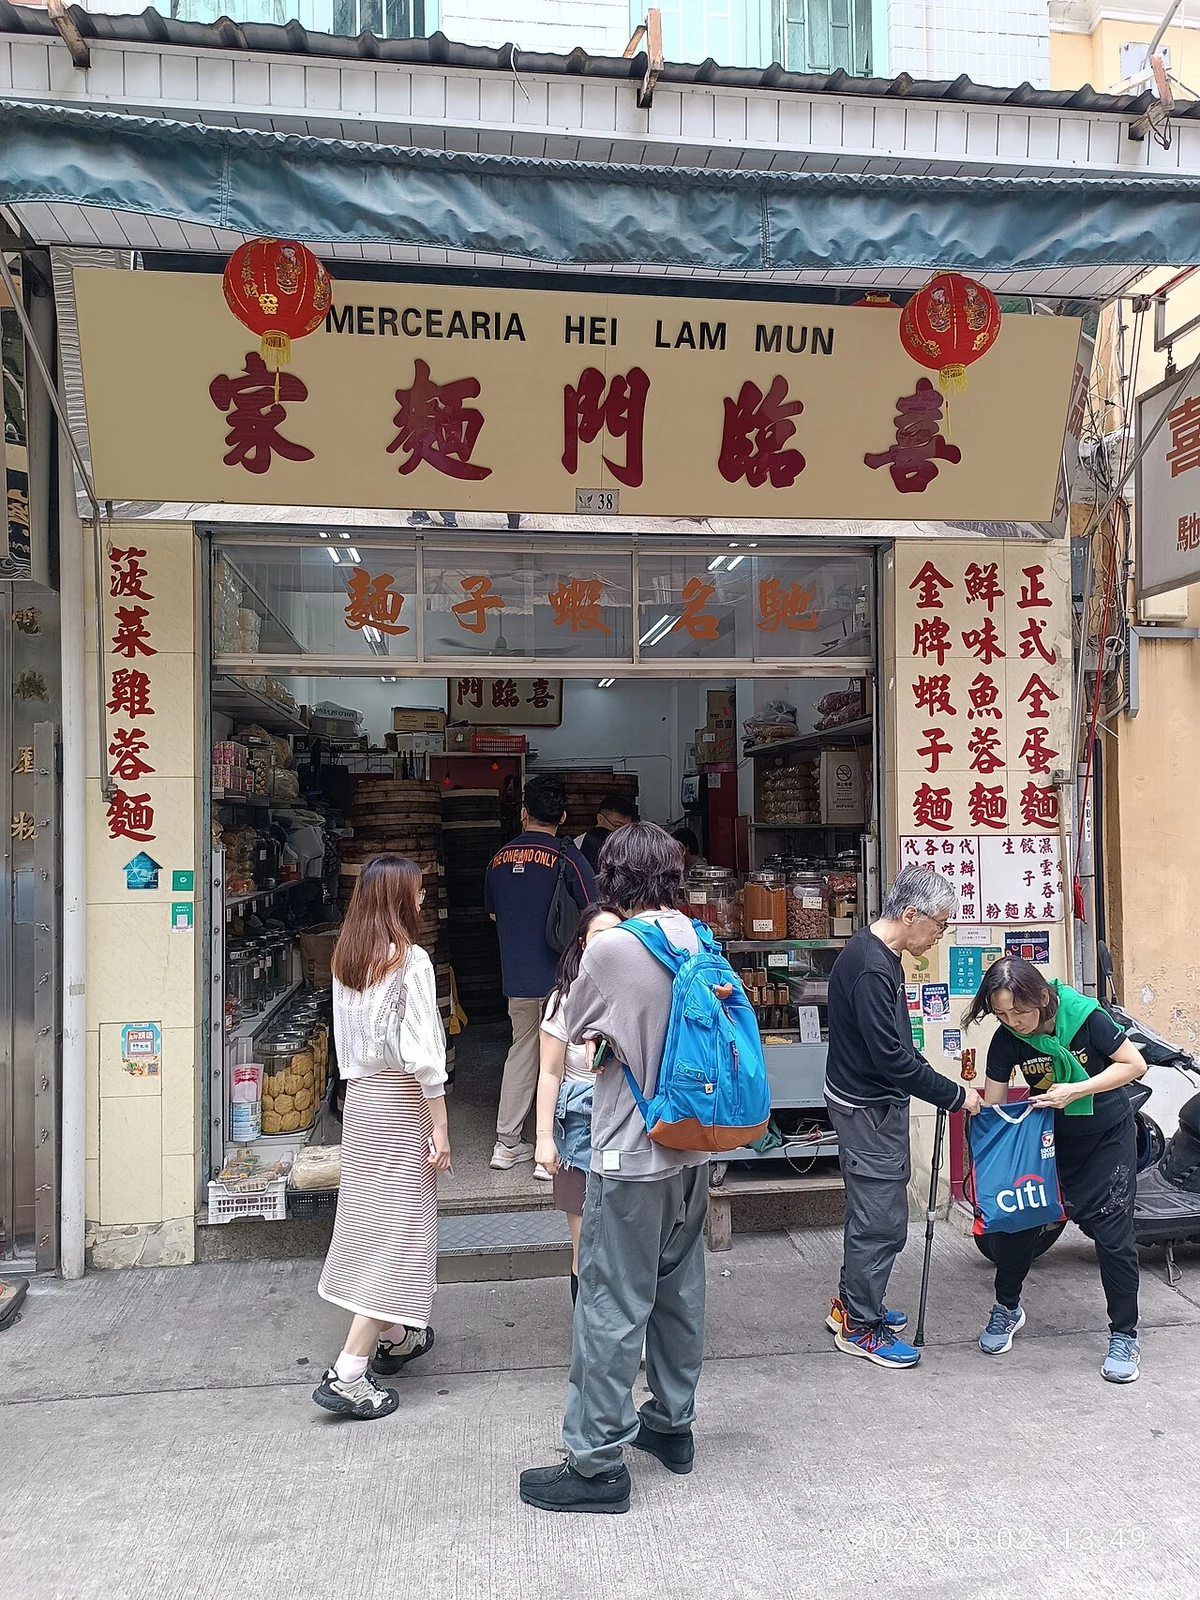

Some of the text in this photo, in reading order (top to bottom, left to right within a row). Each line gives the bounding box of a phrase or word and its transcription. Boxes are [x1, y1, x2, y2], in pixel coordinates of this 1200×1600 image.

[325, 304, 834, 355] MERCEARIA HEI LAM MUN
[597, 493, 613, 510] 38
[107, 546, 157, 843] 菠菜雞蓉麵
[908, 560, 957, 831] 金牌蝦子麵
[960, 562, 1009, 830] 鮮味魚蓉麵
[1016, 565, 1060, 829] 正式全蛋麵
[502, 849, 520, 863] ONE
[519, 849, 534, 863] AND
[534, 850, 558, 868] ONLY
[1019, 837, 1037, 919] 餃子皮
[996, 1180, 1048, 1213] citi
